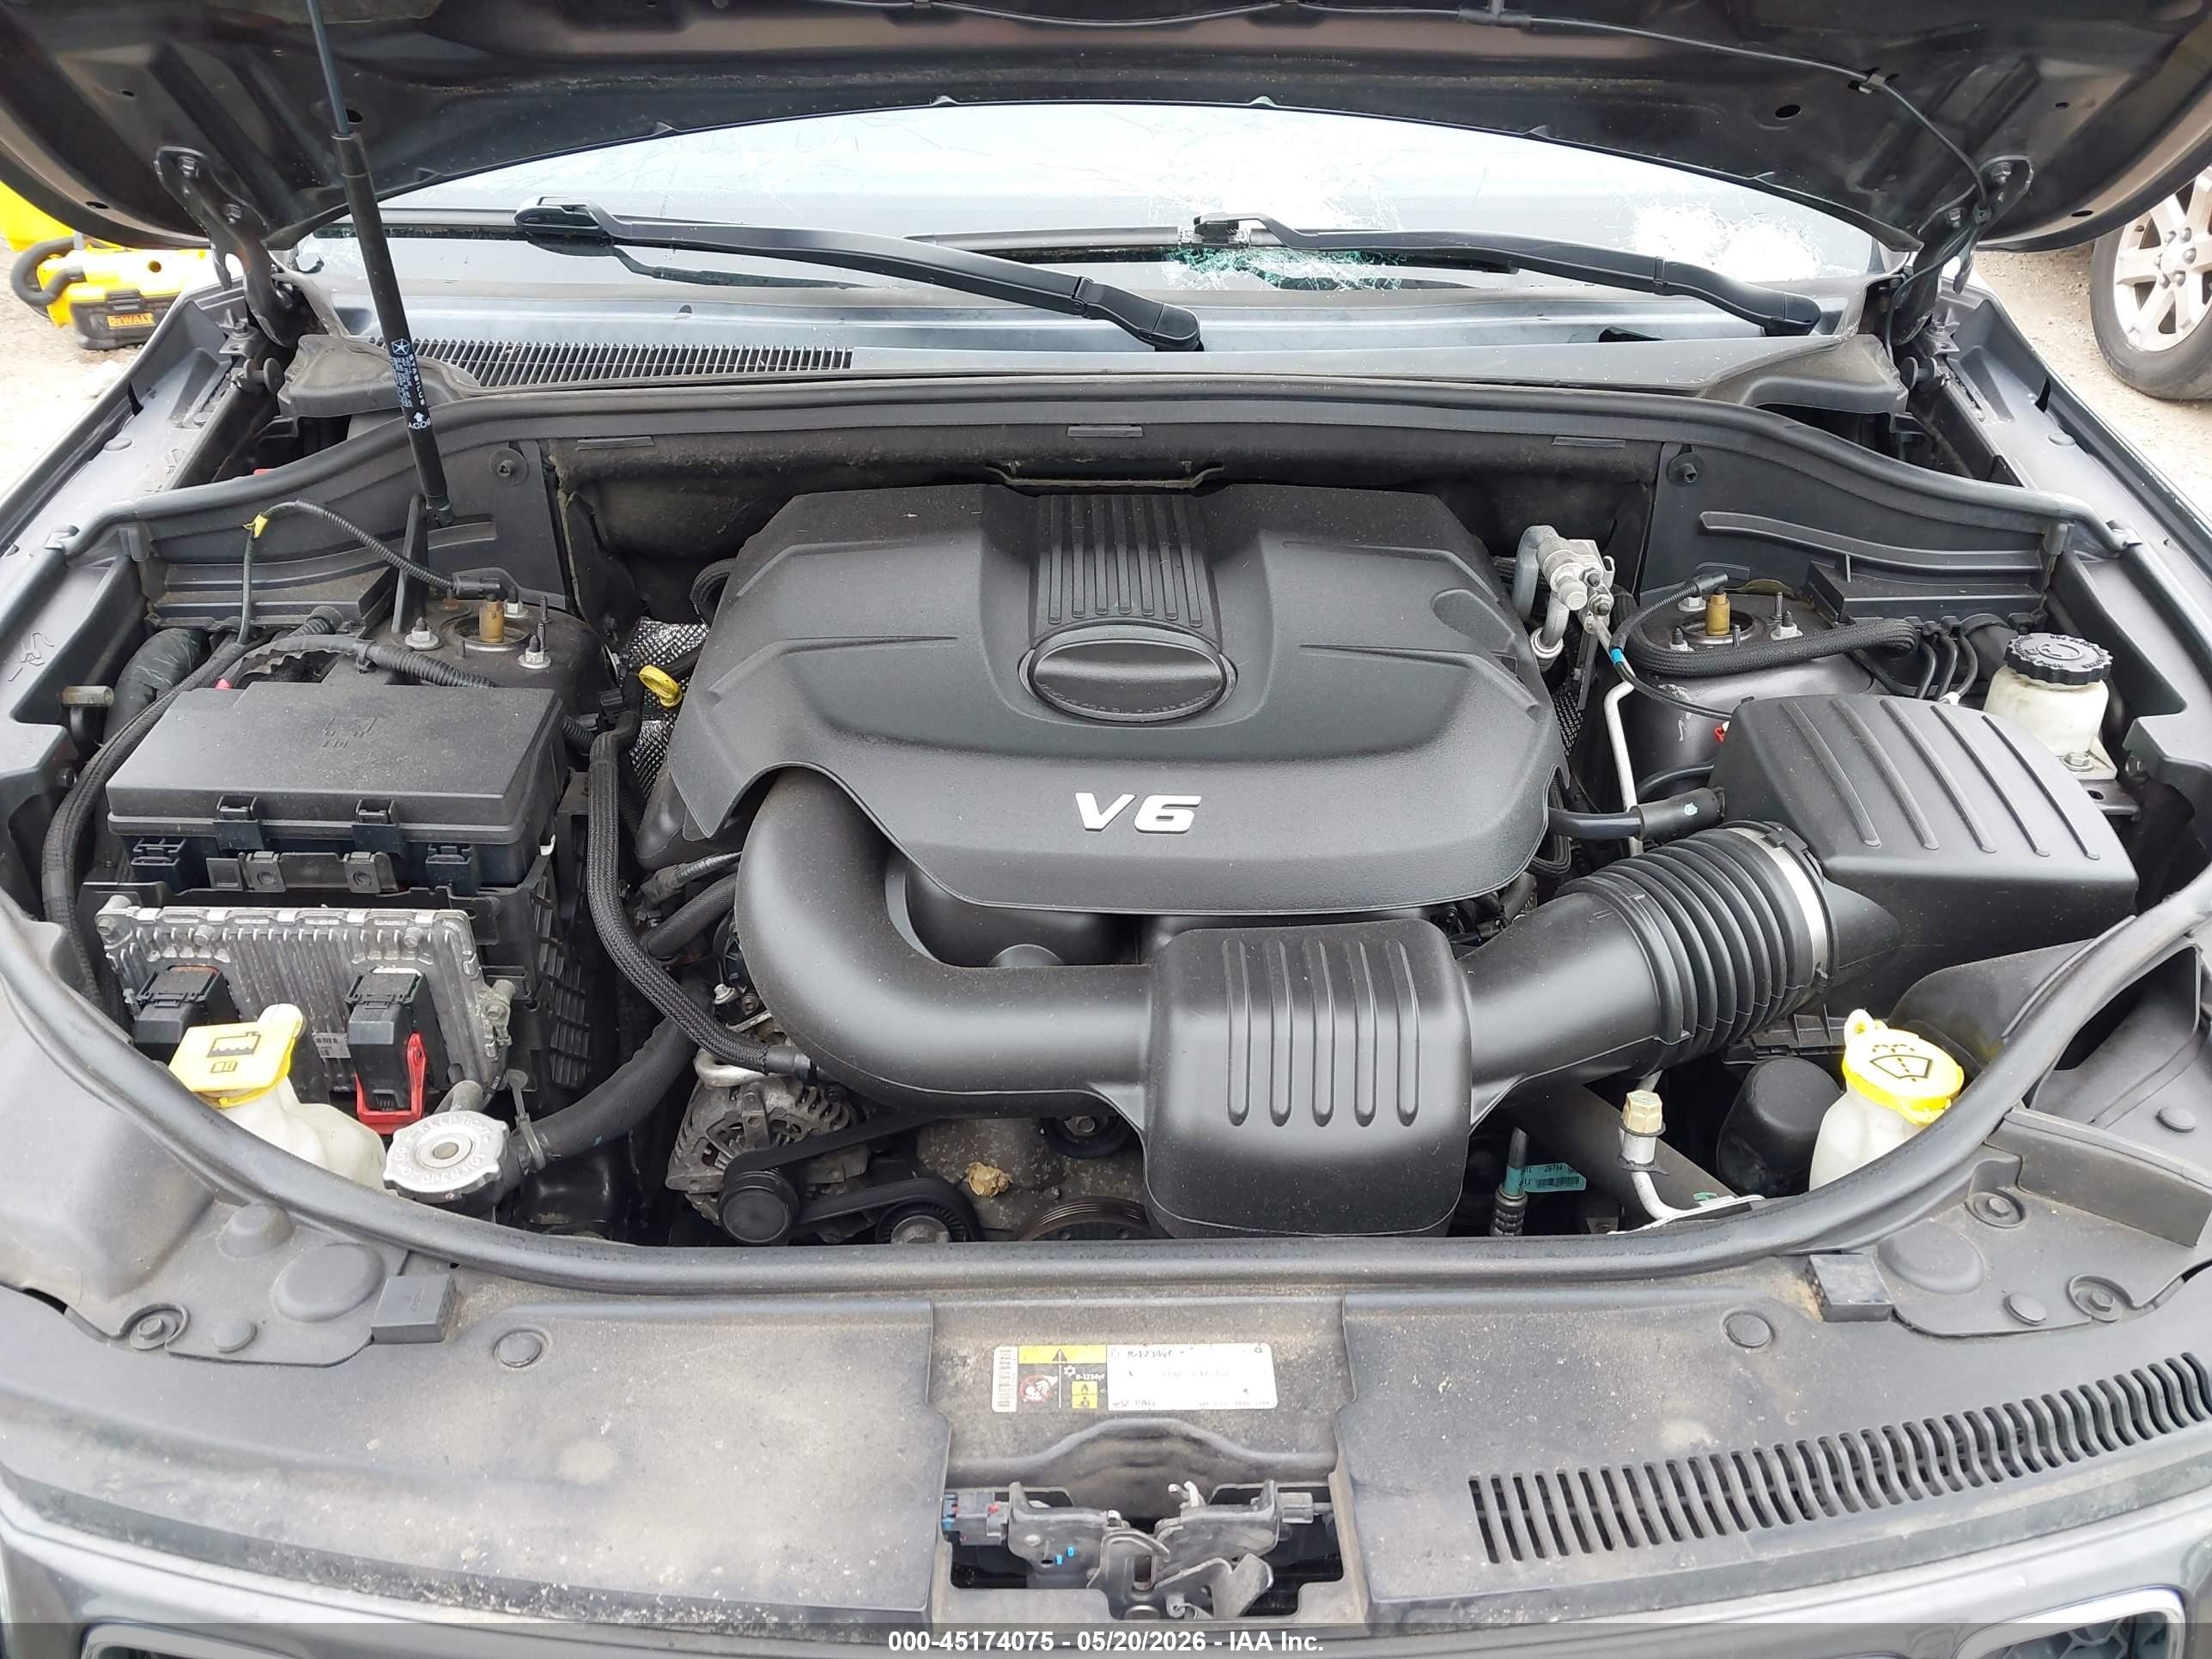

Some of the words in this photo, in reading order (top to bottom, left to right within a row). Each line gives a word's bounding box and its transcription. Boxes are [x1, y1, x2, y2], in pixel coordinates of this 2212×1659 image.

[409, 354, 425, 405] STABILUS
[408, 417, 431, 429] BODY
[1075, 793, 1202, 835] V6
